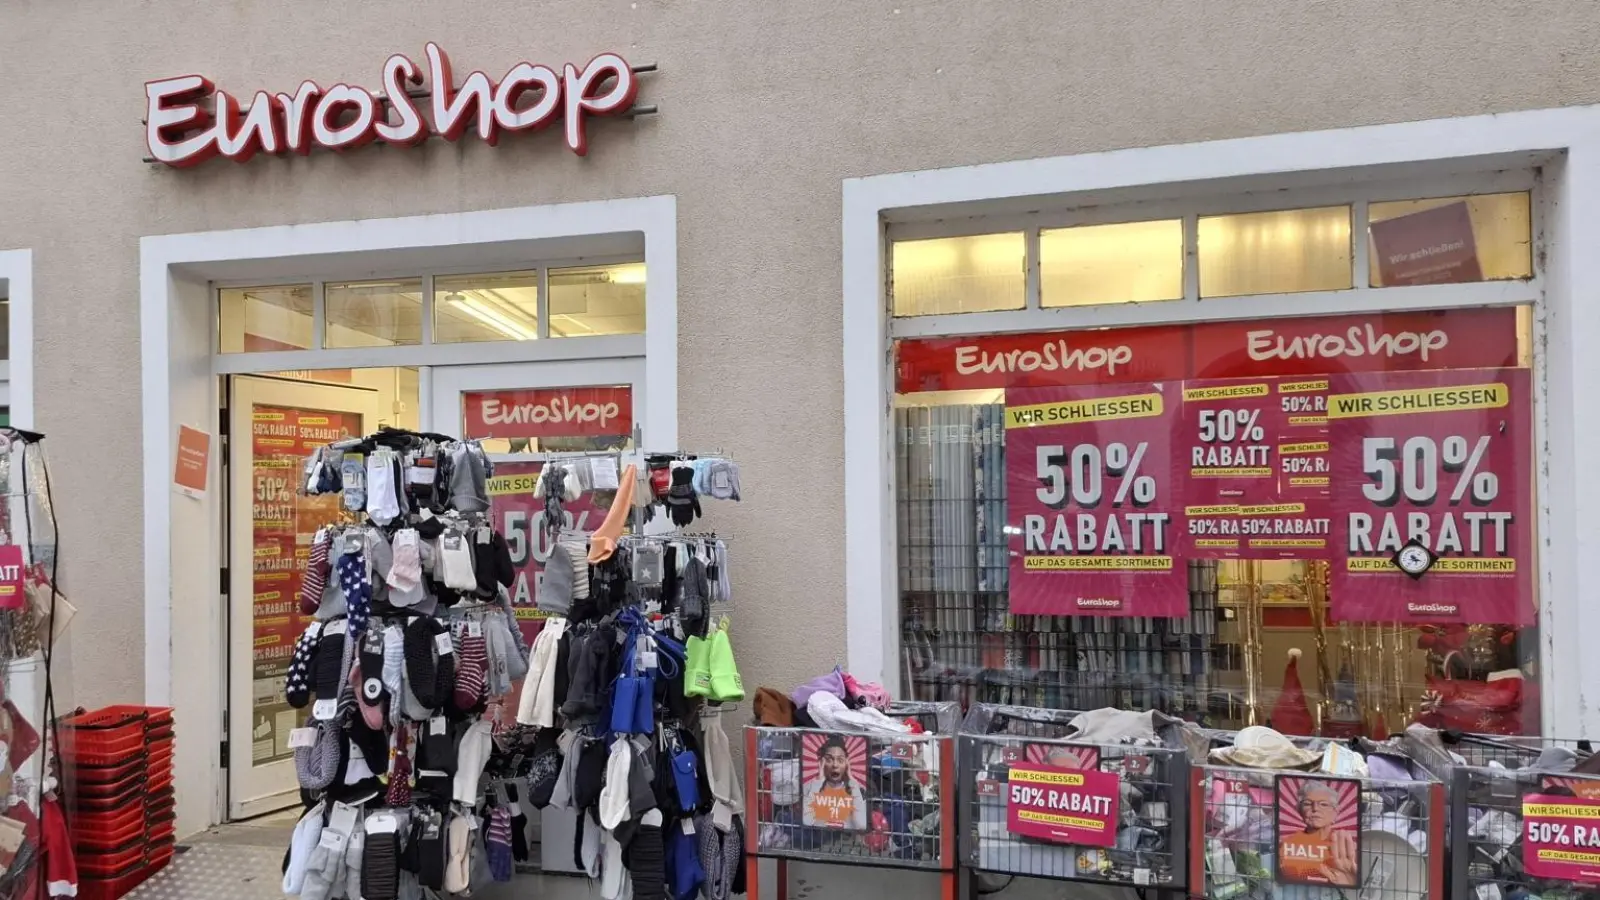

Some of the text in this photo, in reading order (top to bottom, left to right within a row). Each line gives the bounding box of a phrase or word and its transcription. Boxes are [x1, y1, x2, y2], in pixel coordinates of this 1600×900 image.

[145, 41, 637, 167] EuroShop
[1246, 323, 1448, 361] EuroShop
[955, 340, 1132, 375] EuroShop
[1187, 386, 1264, 399] WIR SCHLIESSEN
[1338, 399, 1373, 413] WIR
[1377, 388, 1498, 411] SCHLIESSEN
[481, 396, 620, 428] EuroShop
[1014, 398, 1153, 424] WIR SCHLIESSEN
[1282, 396, 1312, 412] 50%
[270, 424, 297, 437] RABATT
[1199, 408, 1264, 442] 50%
[315, 428, 340, 440] RABATT
[1192, 445, 1270, 466] RABATT
[1036, 442, 1156, 505] 50%
[1282, 457, 1313, 473] 50%
[1362, 435, 1498, 501] 50%
[256, 476, 290, 502] 50%
[488, 480, 513, 492] WIR
[253, 503, 292, 519] RABATT
[1025, 513, 1169, 551] RABATT
[1189, 519, 1218, 534] 50%
[1242, 519, 1272, 534] 50%
[1274, 518, 1330, 534] RABATT
[1349, 511, 1512, 552] RABATT
[1026, 558, 1171, 567] AUF DAS GESAMTE SORTIMENT
[1350, 560, 1395, 569] AUF DAS
[1452, 560, 1513, 570] SORTIMENT
[1014, 771, 1080, 783] WIR SCHLIESSEN
[815, 795, 853, 808] WHAT
[1011, 785, 1112, 815] 50% RABATT
[1528, 806, 1547, 814] WIR
[1528, 821, 1570, 845] 50%
[1284, 842, 1328, 859] HALT
